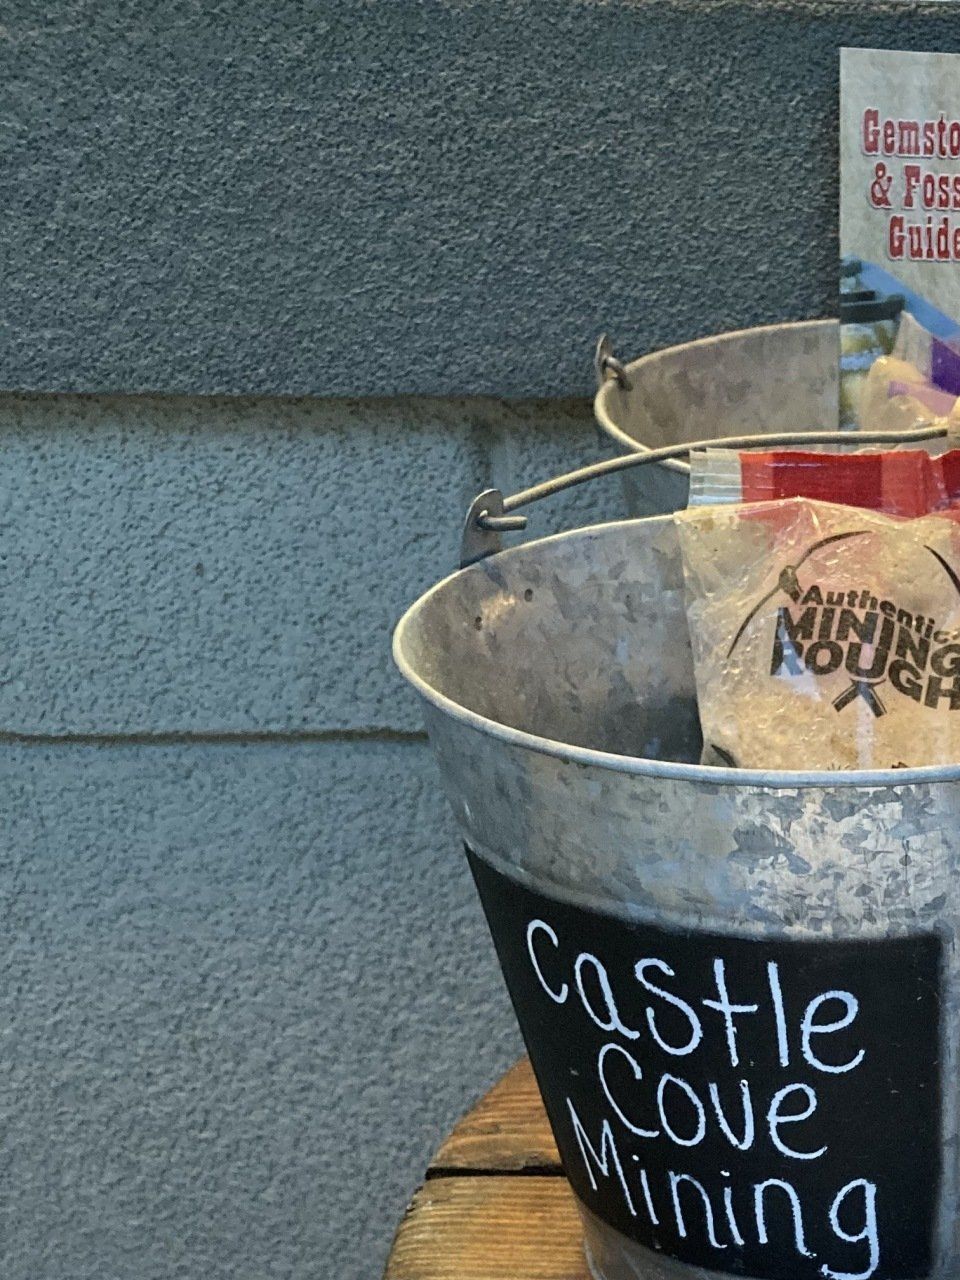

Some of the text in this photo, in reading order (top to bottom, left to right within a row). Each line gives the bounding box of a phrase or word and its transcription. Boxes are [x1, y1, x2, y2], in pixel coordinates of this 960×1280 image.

[870, 162, 891, 206] &
[801, 585, 950, 644] Authentic
[527, 919, 865, 1073] Castle
[598, 1043, 827, 1160] Cove
[566, 1097, 879, 1280] Mining
